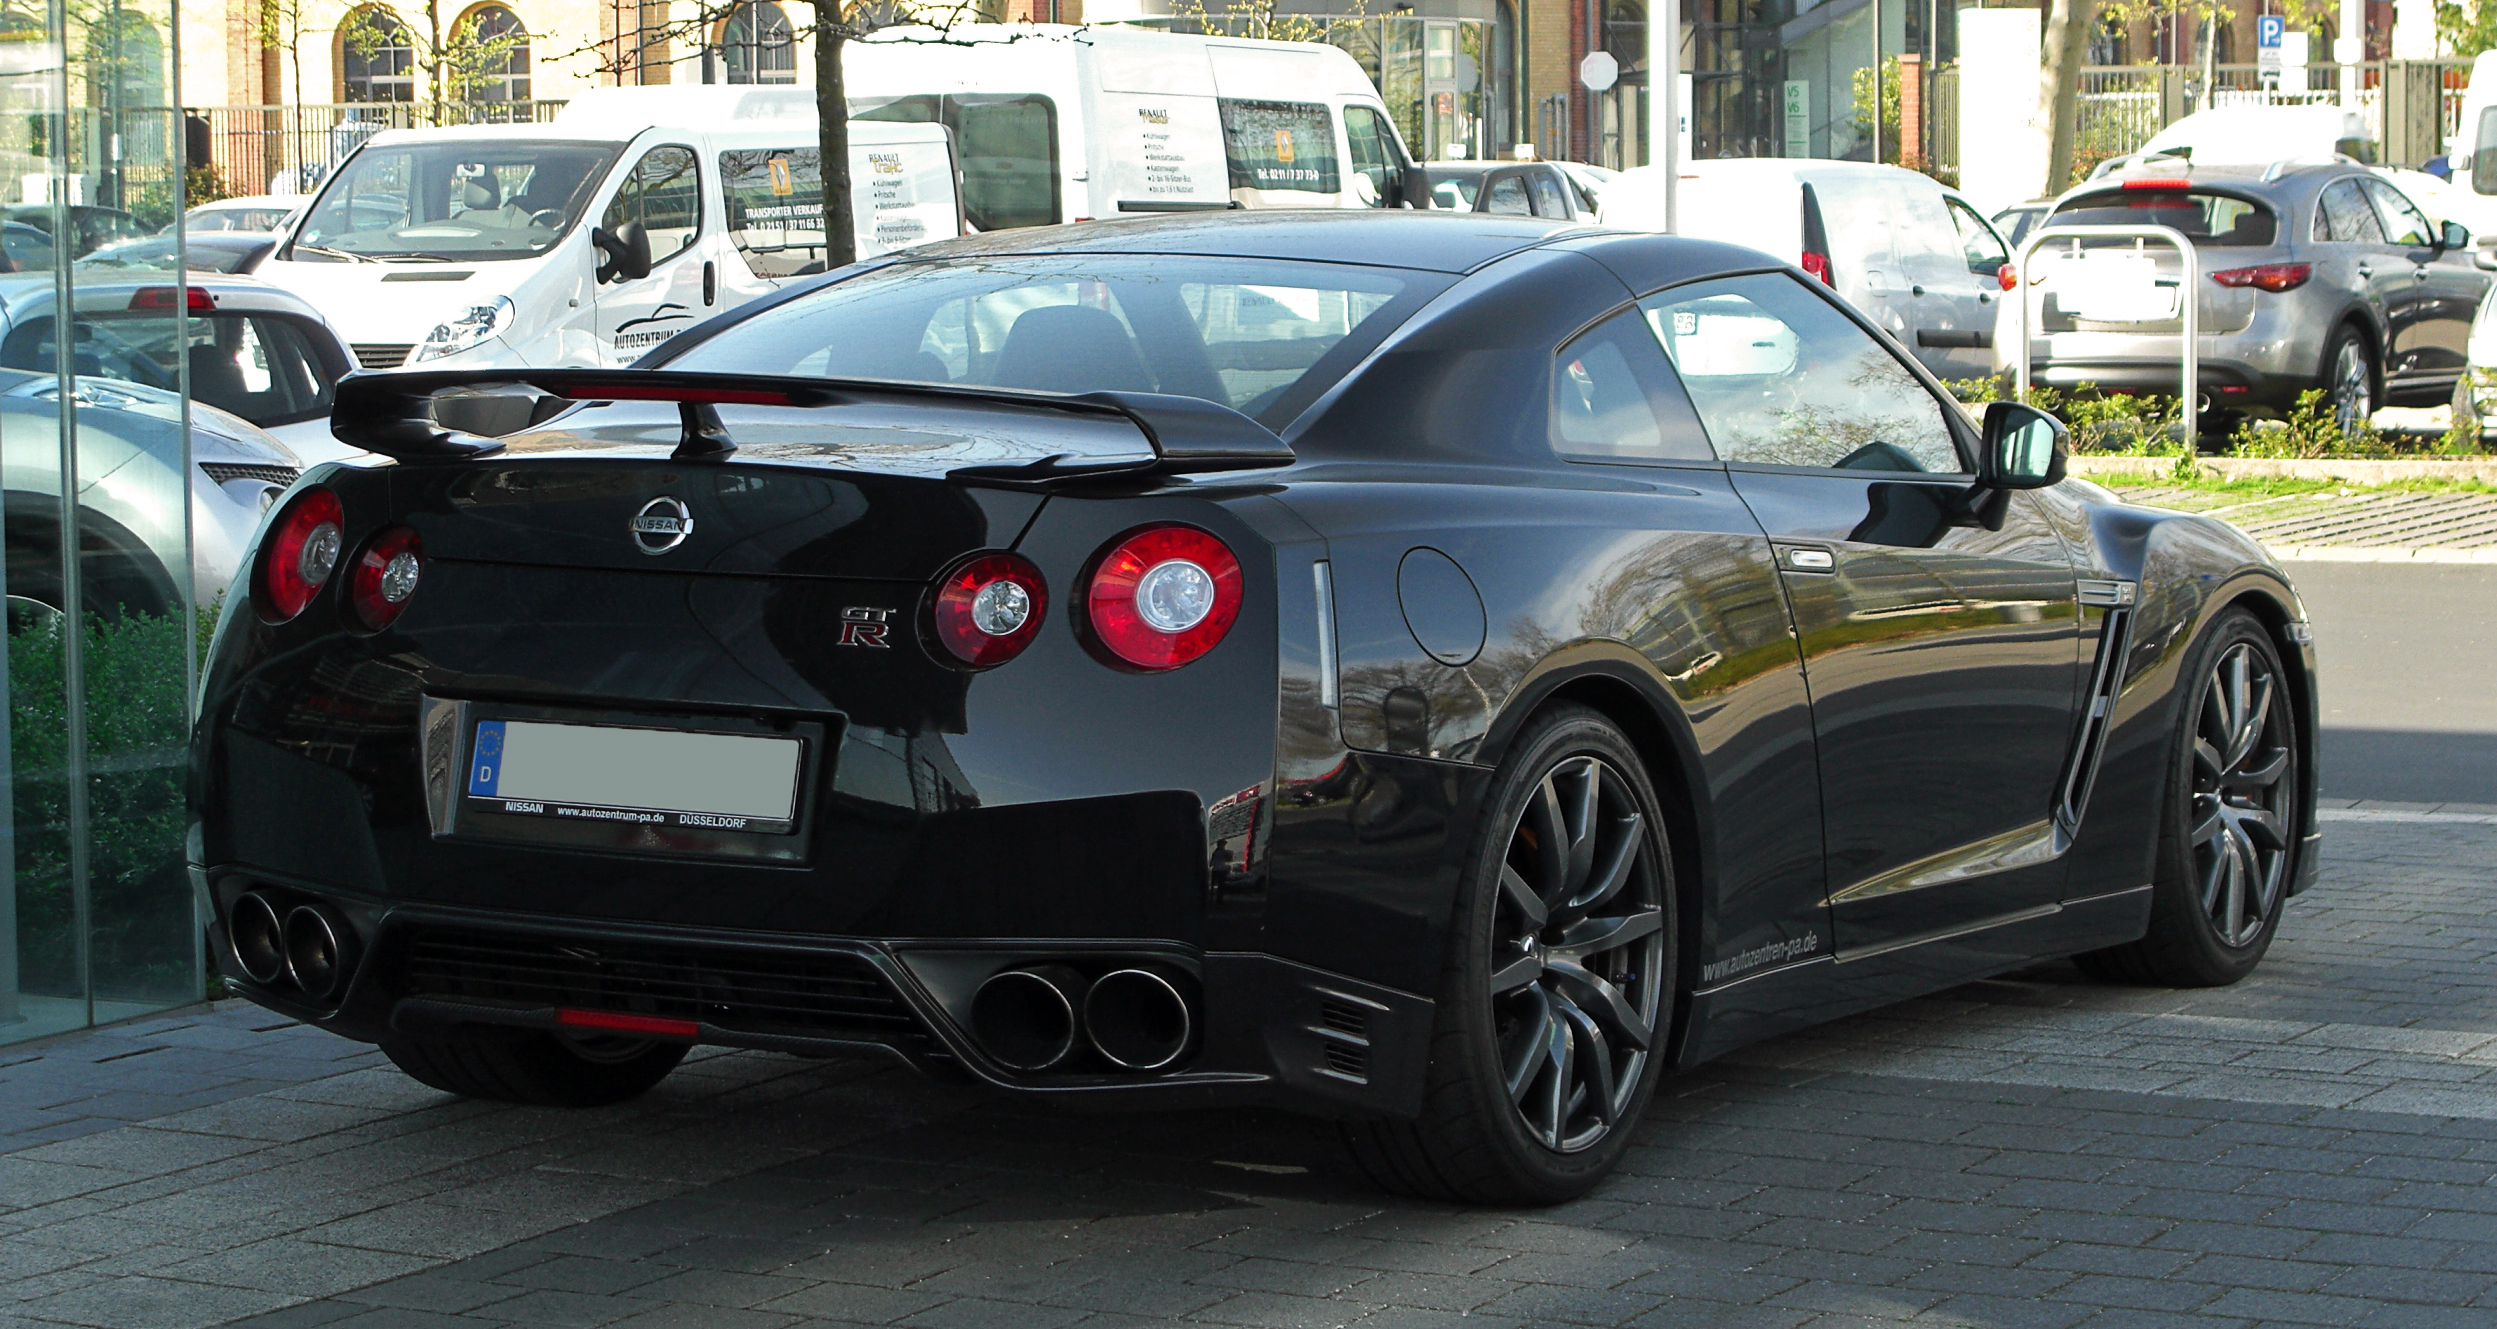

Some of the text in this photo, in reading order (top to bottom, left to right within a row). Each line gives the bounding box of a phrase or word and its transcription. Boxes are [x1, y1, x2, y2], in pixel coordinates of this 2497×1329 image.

[2264, 19, 2279, 46] P
[1787, 86, 1800, 98] V5
[1787, 102, 1800, 113] V6
[1257, 168, 1269, 180] Tel.
[745, 203, 824, 219] TRANSPORTER VERKAUF
[635, 519, 684, 531] NISSAN
[480, 766, 491, 782] D
[505, 801, 747, 829] NISSAN www.autozentrum-pa.de DÜSSELDORF
[1703, 930, 1818, 981] www.autozentren-pa.de
